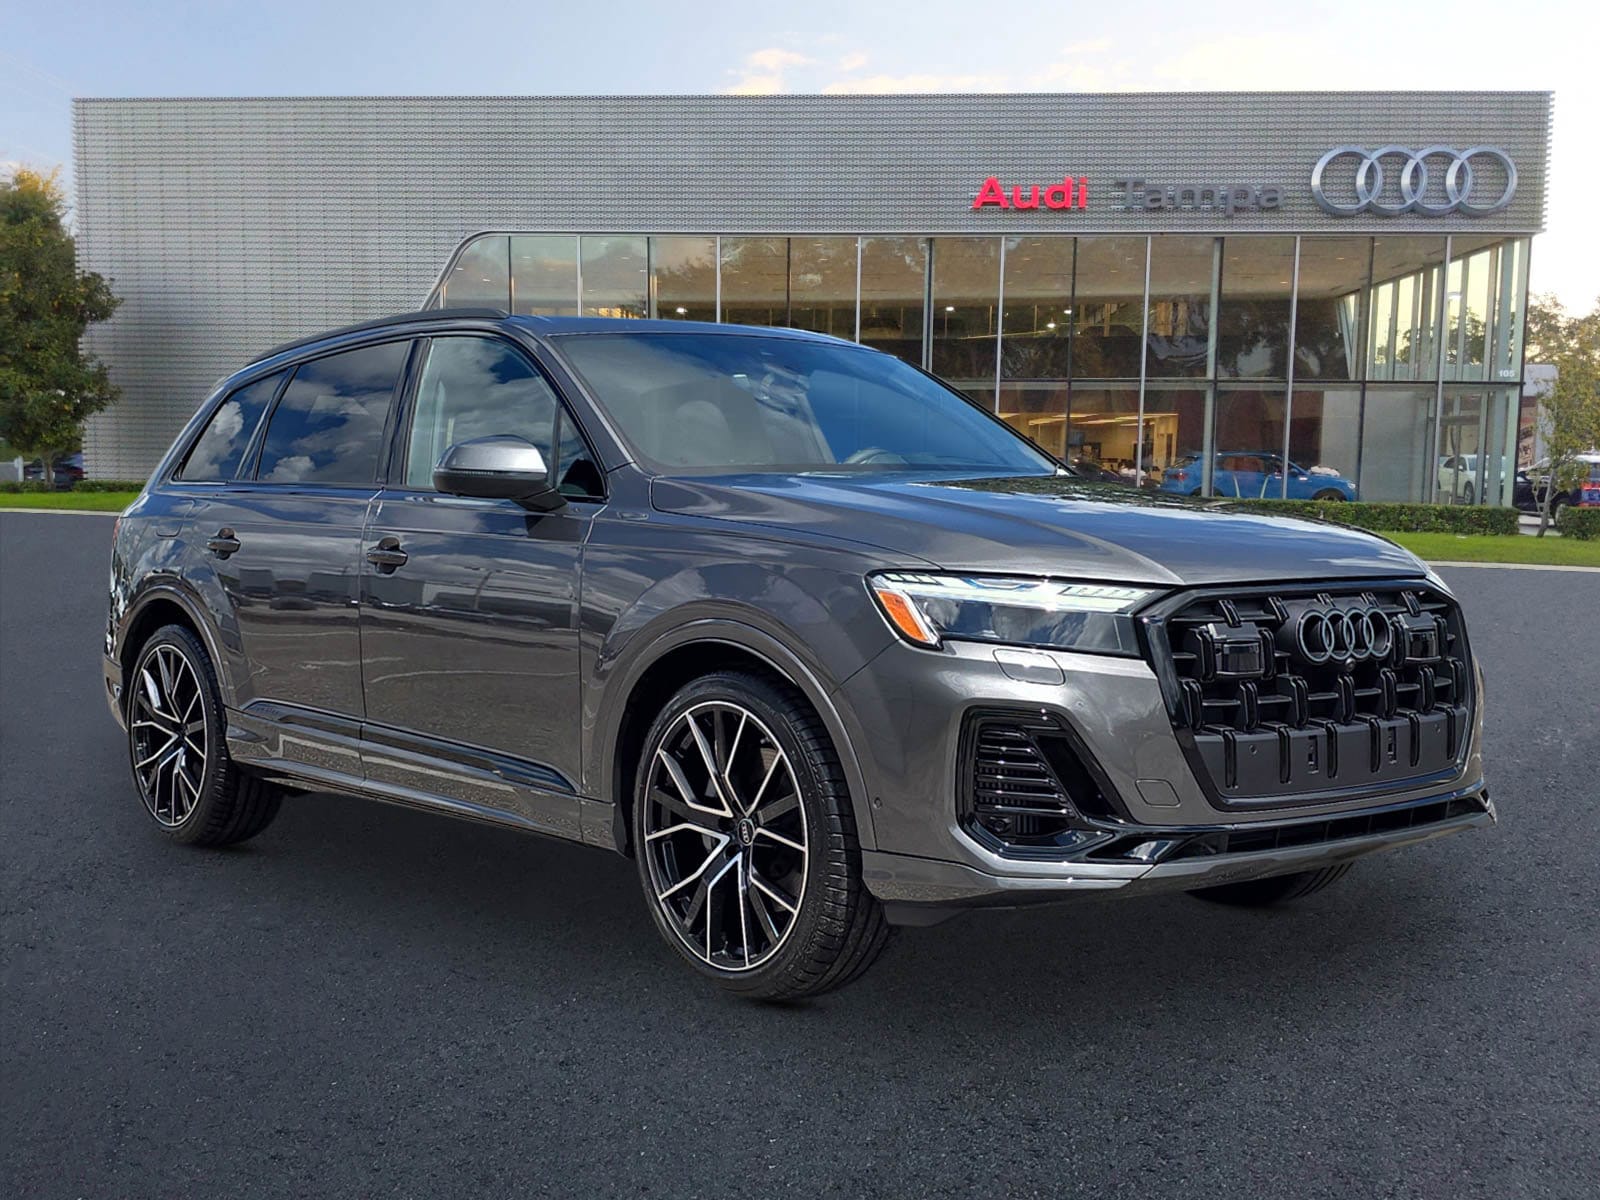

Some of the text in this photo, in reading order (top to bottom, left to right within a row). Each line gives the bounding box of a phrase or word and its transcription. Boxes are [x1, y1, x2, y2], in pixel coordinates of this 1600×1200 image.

[972, 175, 1284, 217] Audi Tampa
[1499, 369, 1515, 378] 105
